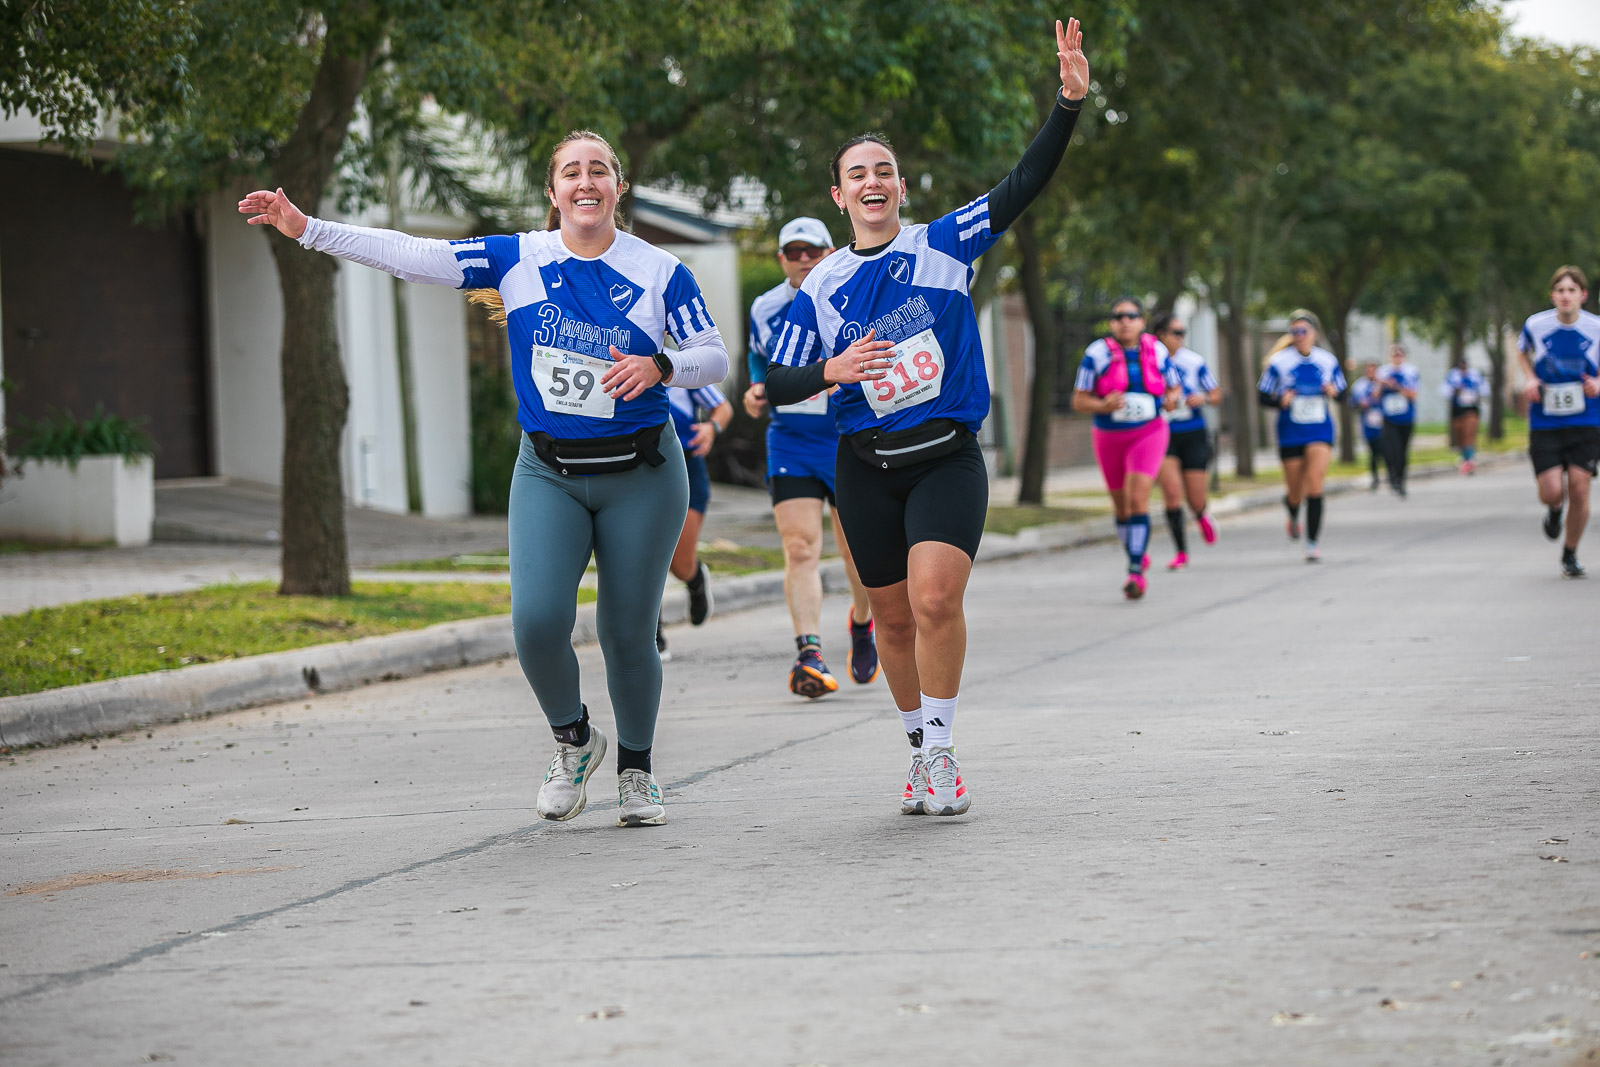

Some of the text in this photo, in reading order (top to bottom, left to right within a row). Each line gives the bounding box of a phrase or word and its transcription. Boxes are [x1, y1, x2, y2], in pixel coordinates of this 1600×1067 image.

[533, 302, 631, 349] 3 MARATÓN
[863, 294, 930, 341] MARATÓN
[548, 366, 595, 401] 59
[873, 351, 939, 402] 518
